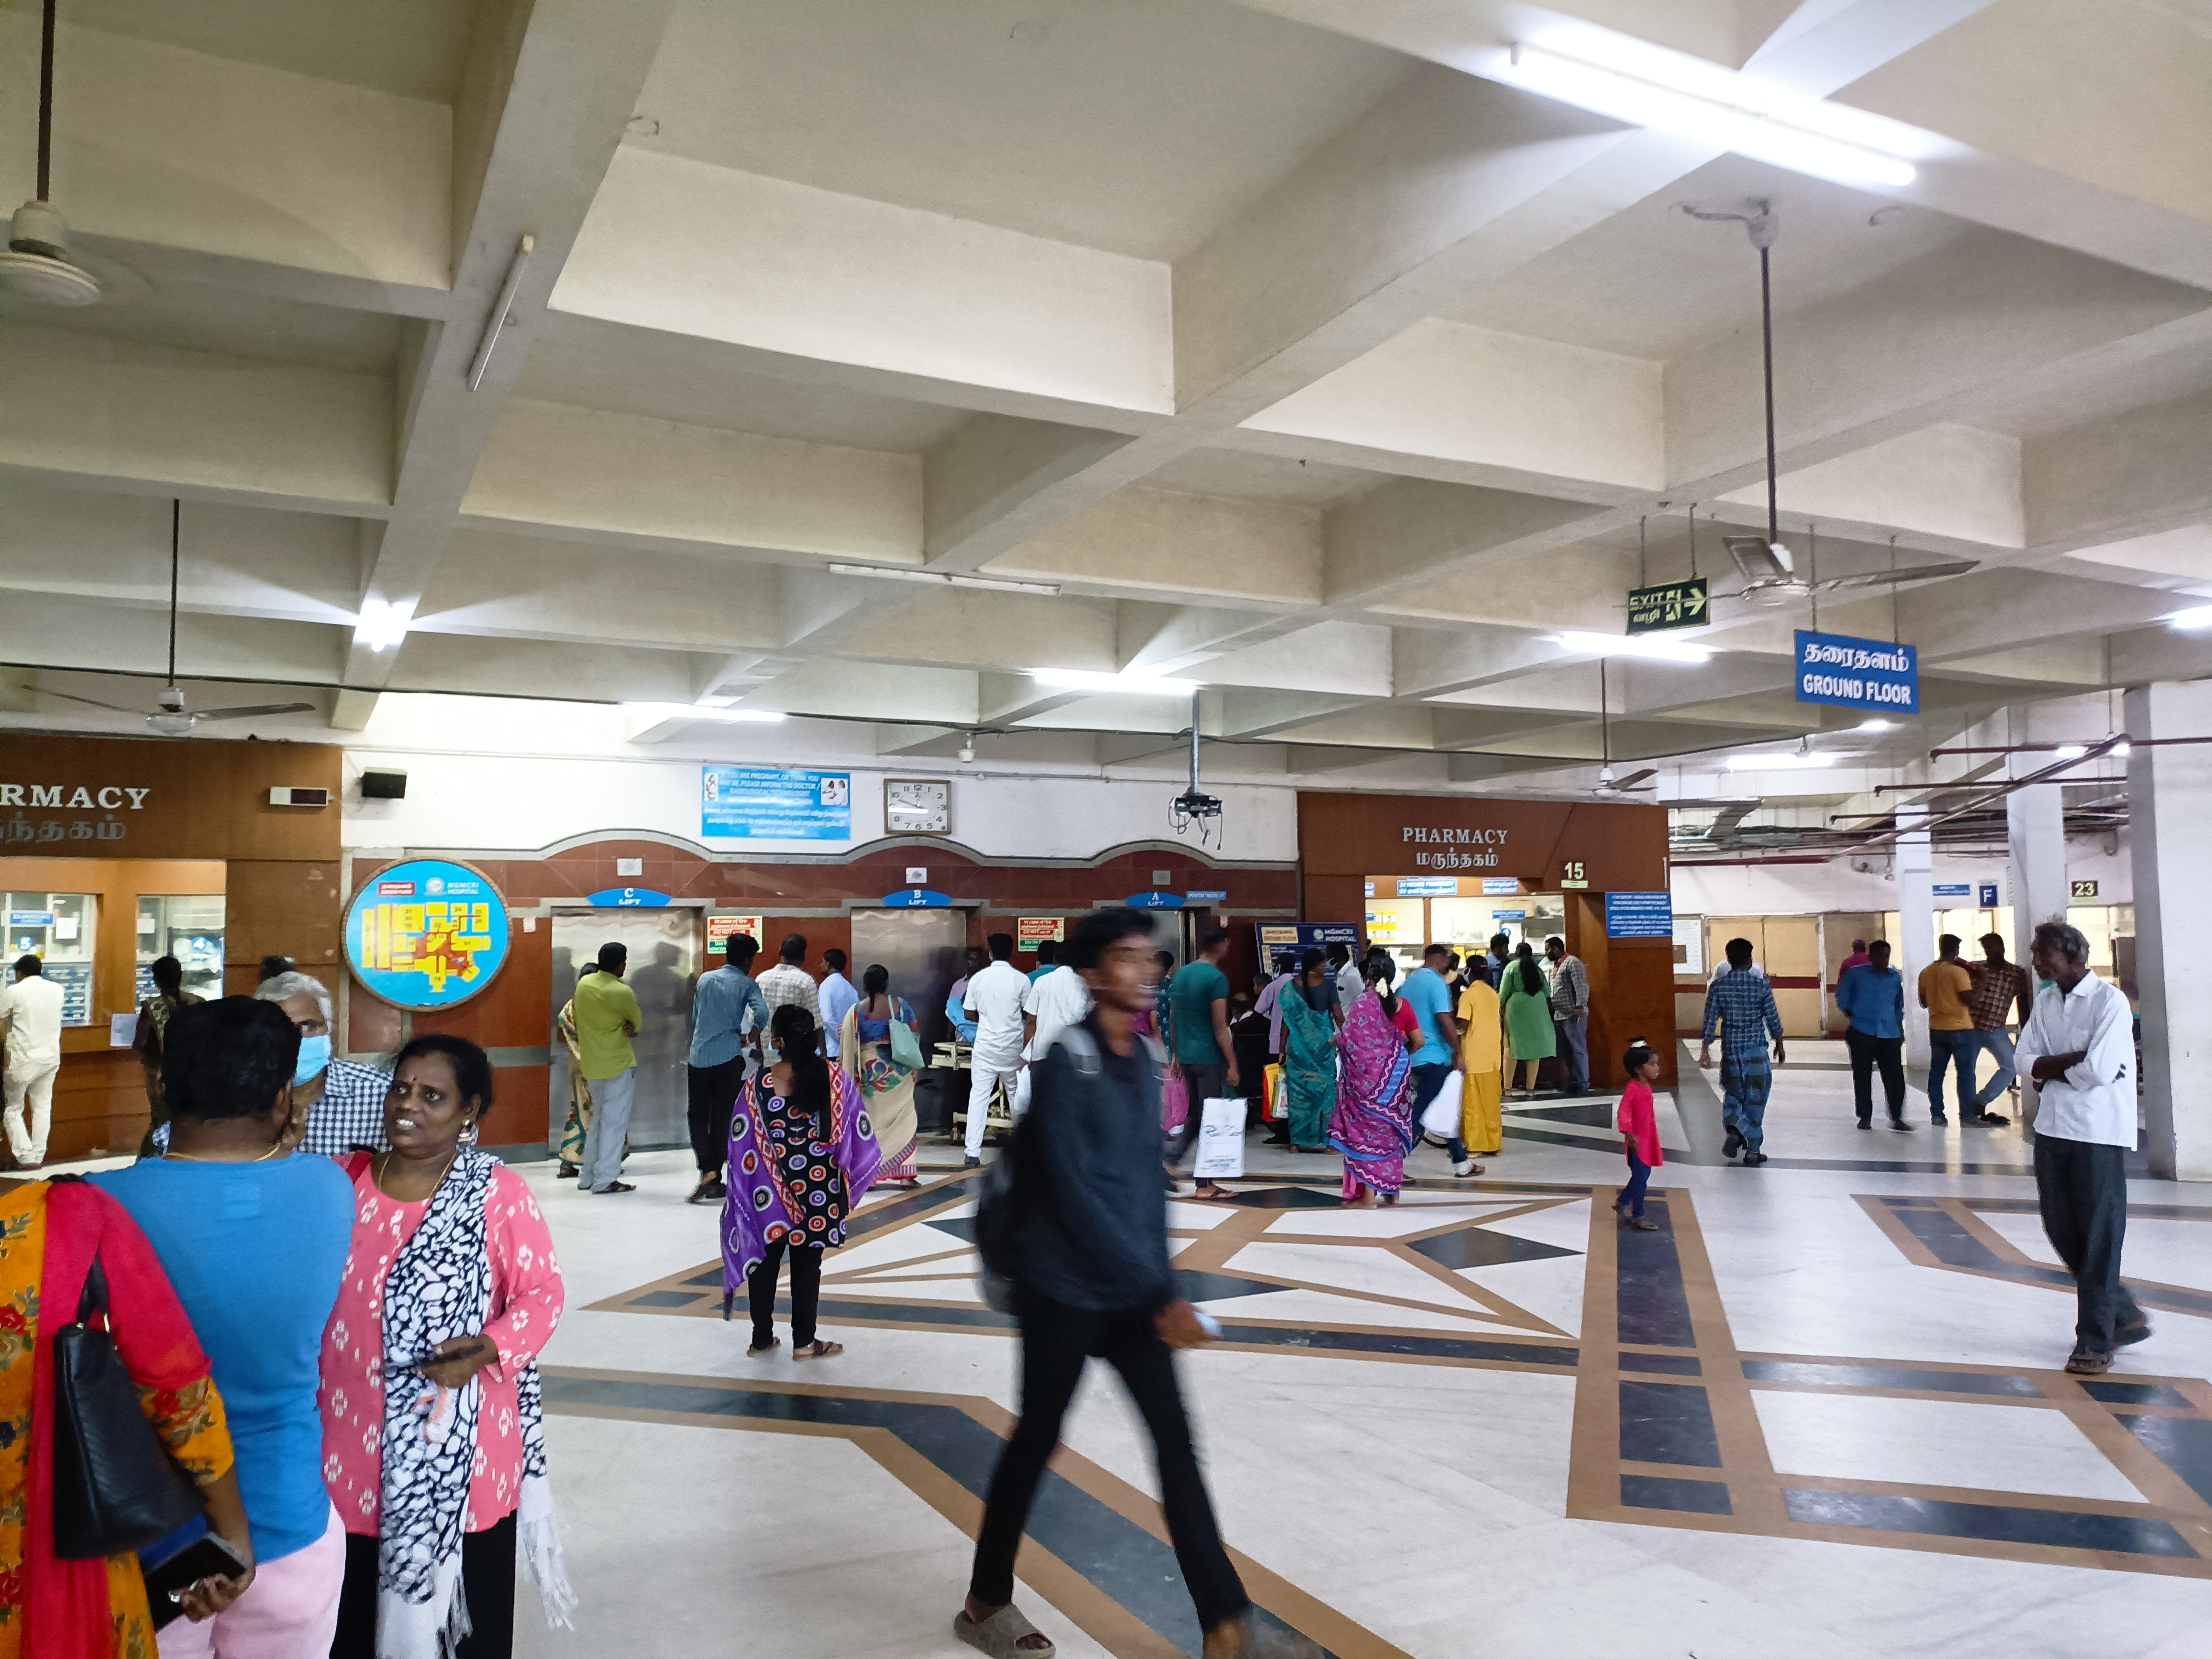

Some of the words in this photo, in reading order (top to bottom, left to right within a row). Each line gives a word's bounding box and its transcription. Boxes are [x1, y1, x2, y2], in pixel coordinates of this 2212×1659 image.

[1629, 591, 1665, 611] EXIT
[1803, 643, 1910, 673] தரைதளம்
[1803, 674, 1864, 700] GROUND
[1866, 680, 1912, 705] FLOOR
[1402, 827, 1508, 844] PHARMACY
[1416, 847, 1499, 870] மருந்தகம்
[1564, 861, 1584, 879] 15
[624, 887, 634, 898] C
[913, 889, 921, 898] B
[1151, 892, 1159, 900] A
[1983, 889, 1993, 903] F
[2074, 882, 2095, 896] 23
[20, 938, 32, 950] 5
[193, 937, 207, 950] 4
